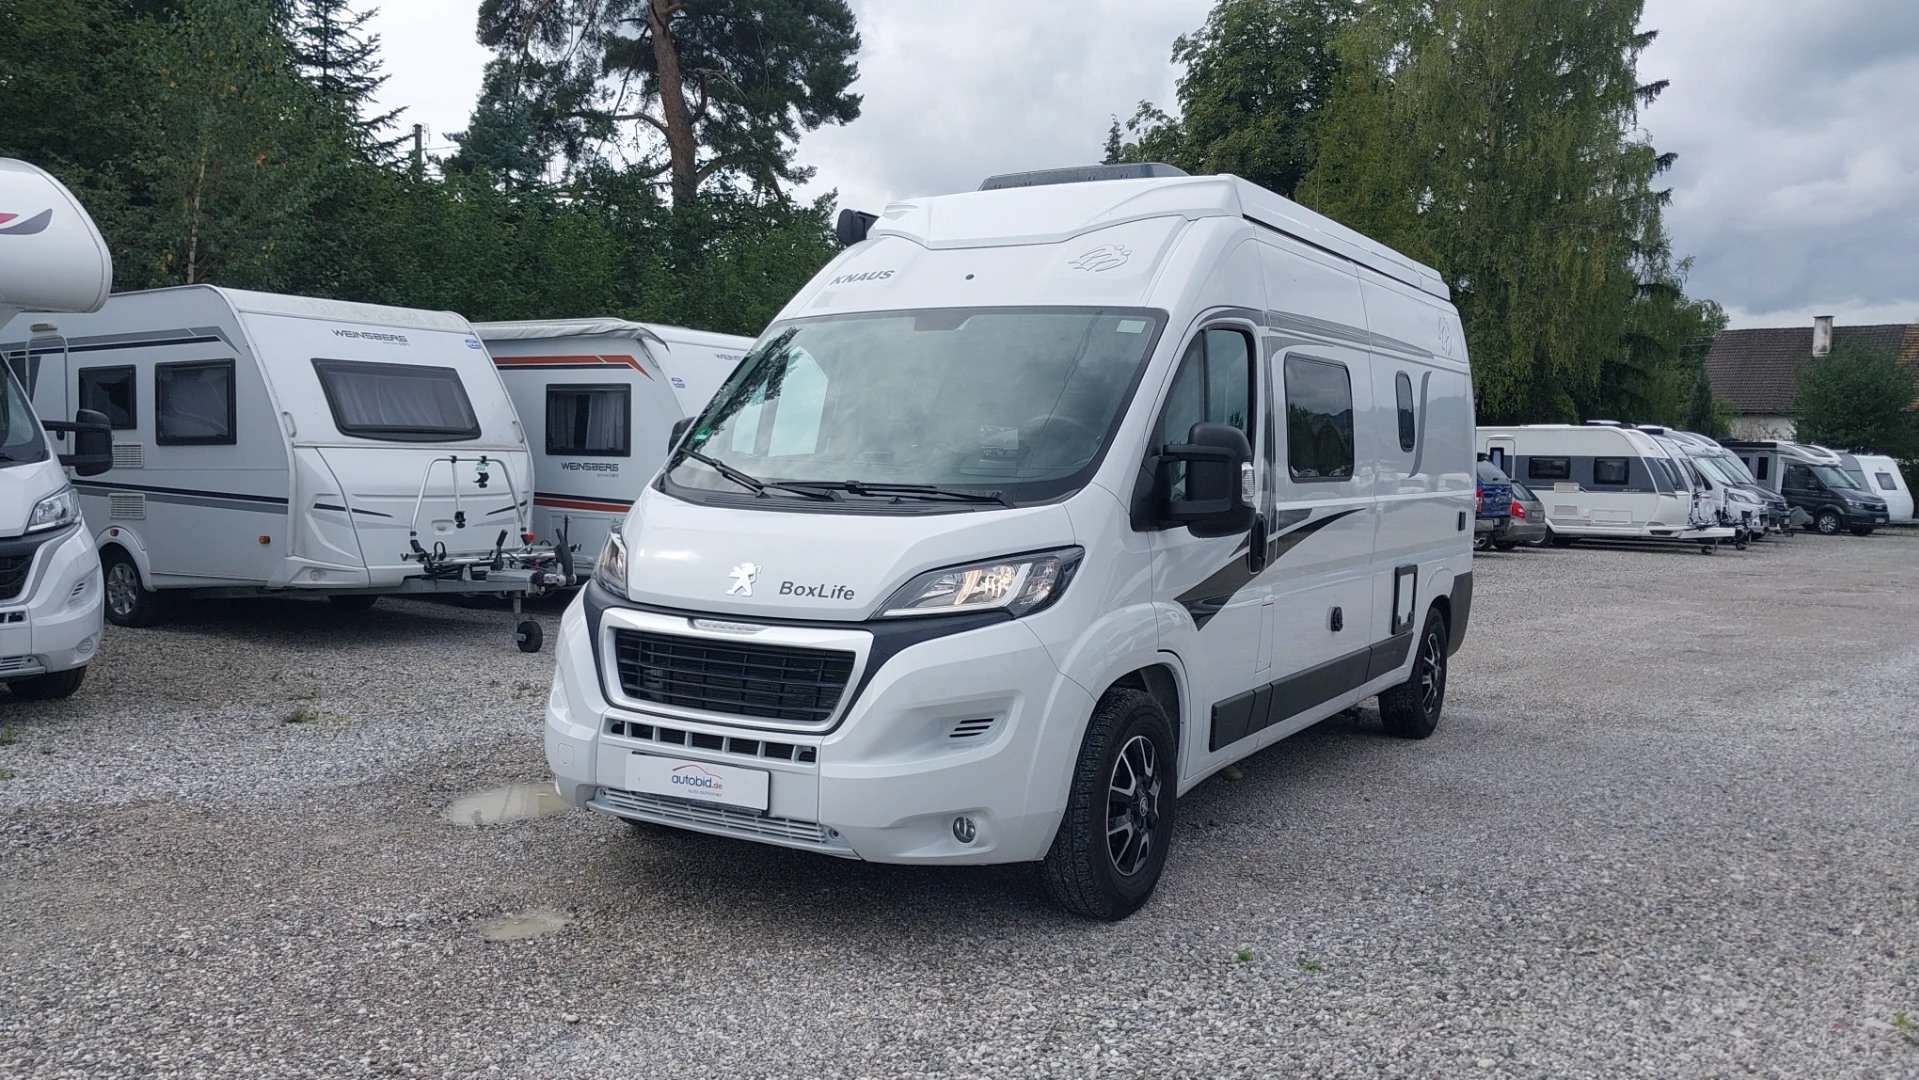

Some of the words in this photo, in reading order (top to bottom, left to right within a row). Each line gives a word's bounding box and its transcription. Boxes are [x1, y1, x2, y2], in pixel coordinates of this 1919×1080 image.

[829, 270, 895, 286] KNAUS
[330, 328, 409, 343] WEINSBERG
[560, 462, 619, 473] WEINSBERG
[779, 581, 855, 601] BoxLife
[671, 774, 722, 789] autobid.de
